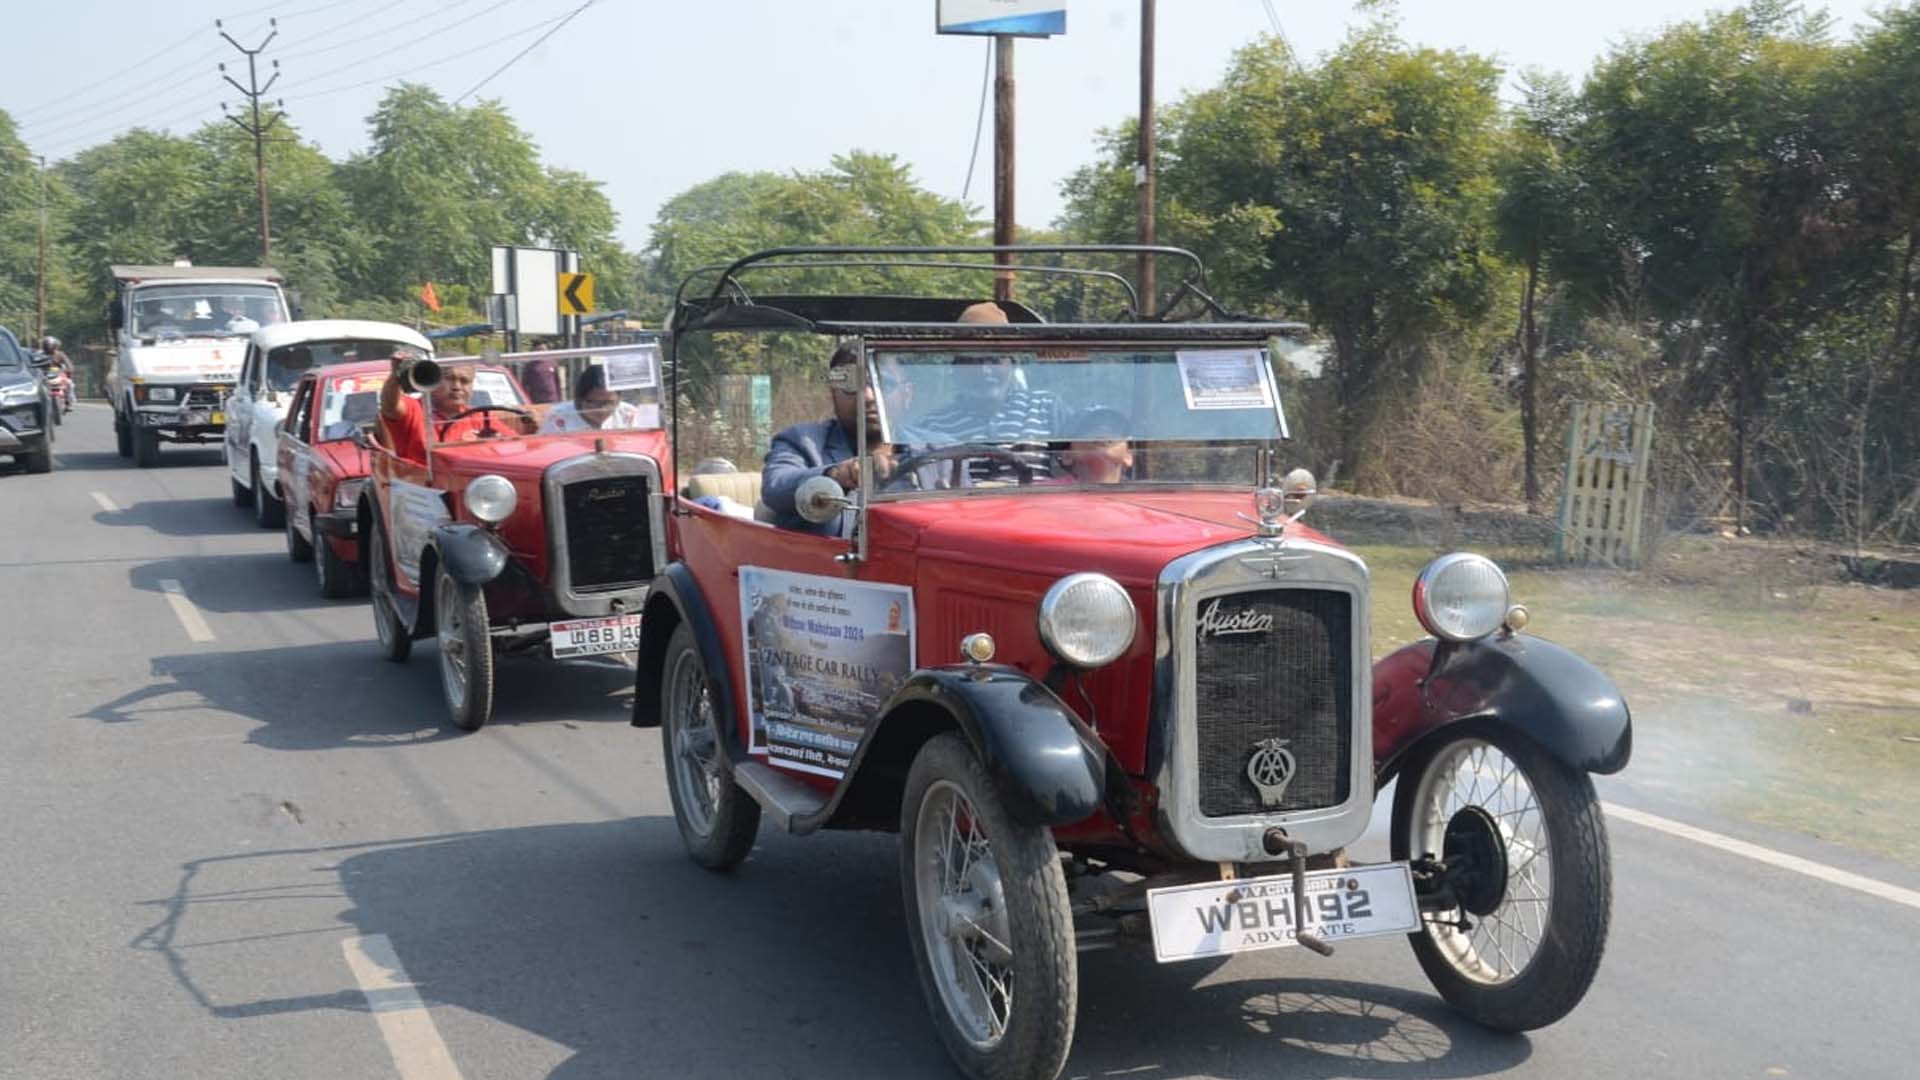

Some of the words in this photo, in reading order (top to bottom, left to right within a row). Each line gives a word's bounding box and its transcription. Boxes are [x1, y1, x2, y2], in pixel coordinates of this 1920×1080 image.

[1197, 598, 1273, 637] Austin
[816, 658, 839, 676] CAR
[841, 663, 880, 681] RALLY
[1242, 923, 1356, 945] ADVOATE
